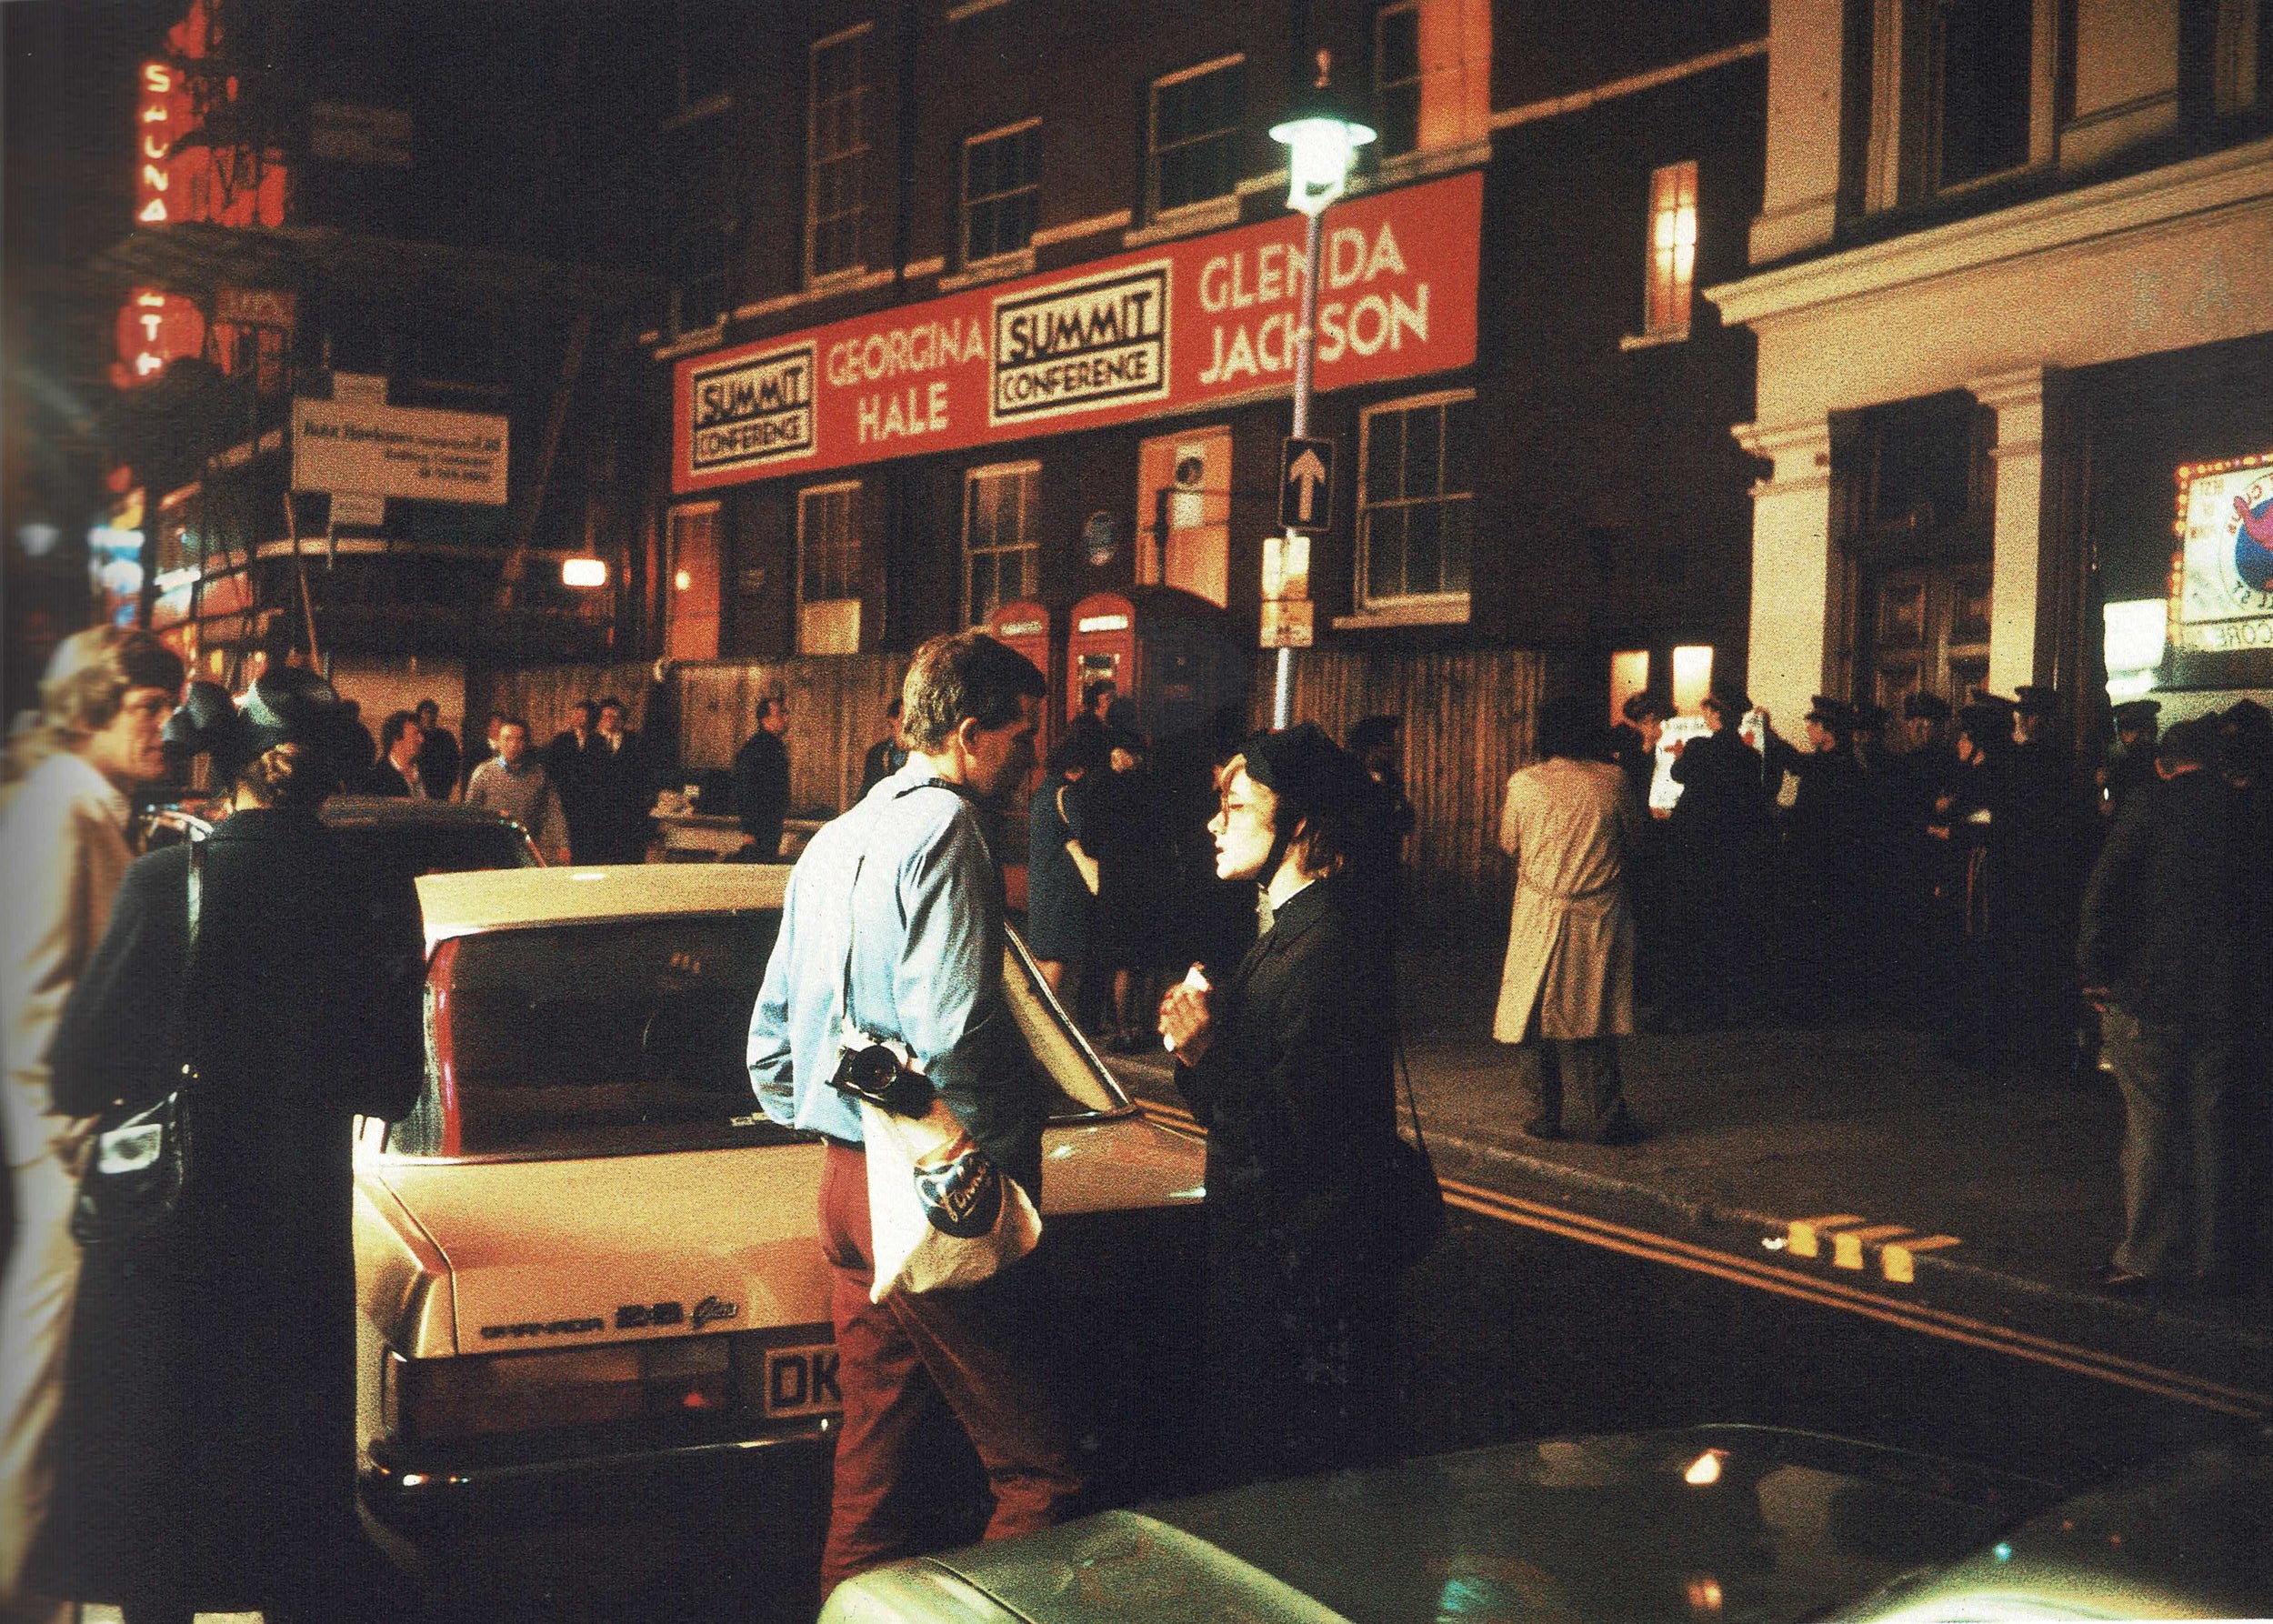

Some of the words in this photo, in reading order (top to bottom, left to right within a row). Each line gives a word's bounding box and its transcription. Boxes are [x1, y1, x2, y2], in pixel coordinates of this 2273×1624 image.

[1199, 222, 1407, 313] GLENDA
[826, 318, 987, 386] GEORGINA
[1009, 290, 1153, 362] SUMMIT
[1199, 283, 1429, 385] JACKSON
[703, 365, 804, 423] SUMMIT
[1004, 350, 1148, 403] CONFERENCE
[699, 415, 800, 455] CONFERENCE
[858, 382, 949, 444] HALE
